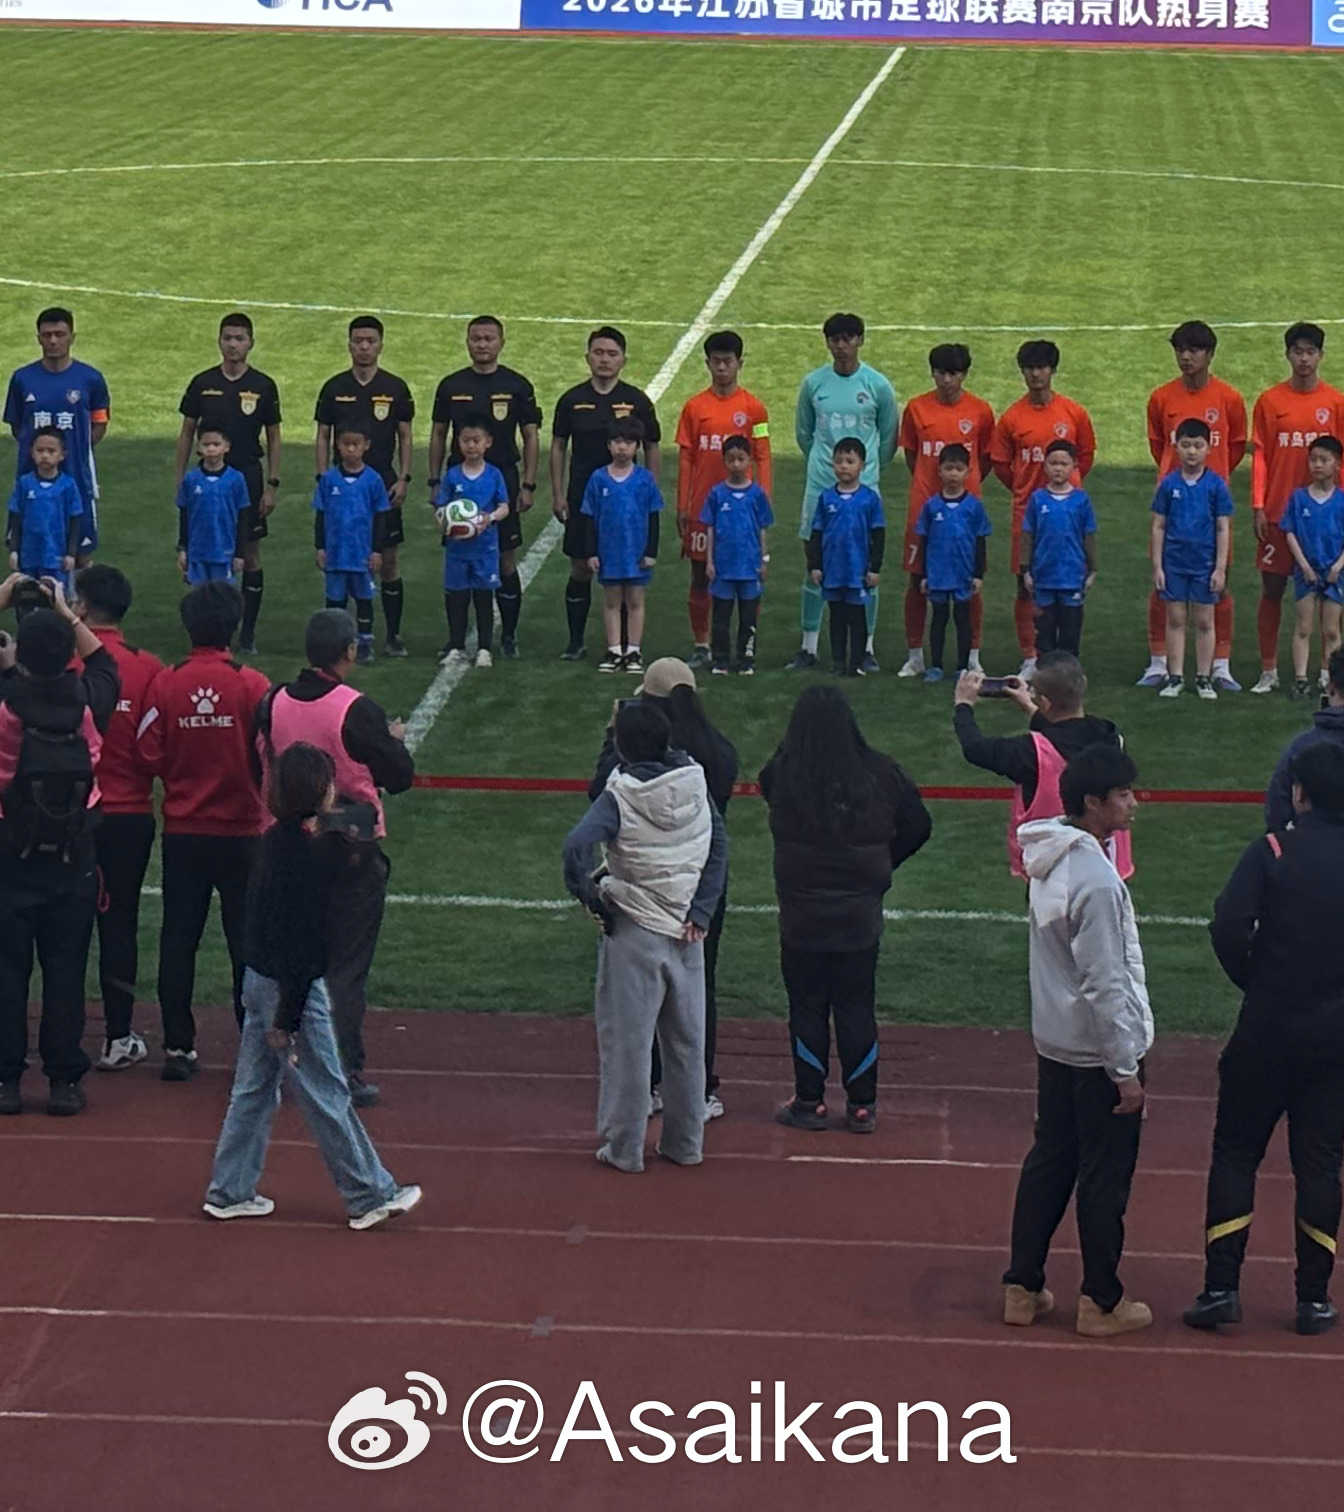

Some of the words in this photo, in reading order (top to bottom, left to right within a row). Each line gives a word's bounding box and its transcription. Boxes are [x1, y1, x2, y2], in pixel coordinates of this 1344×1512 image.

[690, 530, 708, 552] 10
[1261, 543, 1276, 565] 2
[178, 715, 234, 729] KELME
